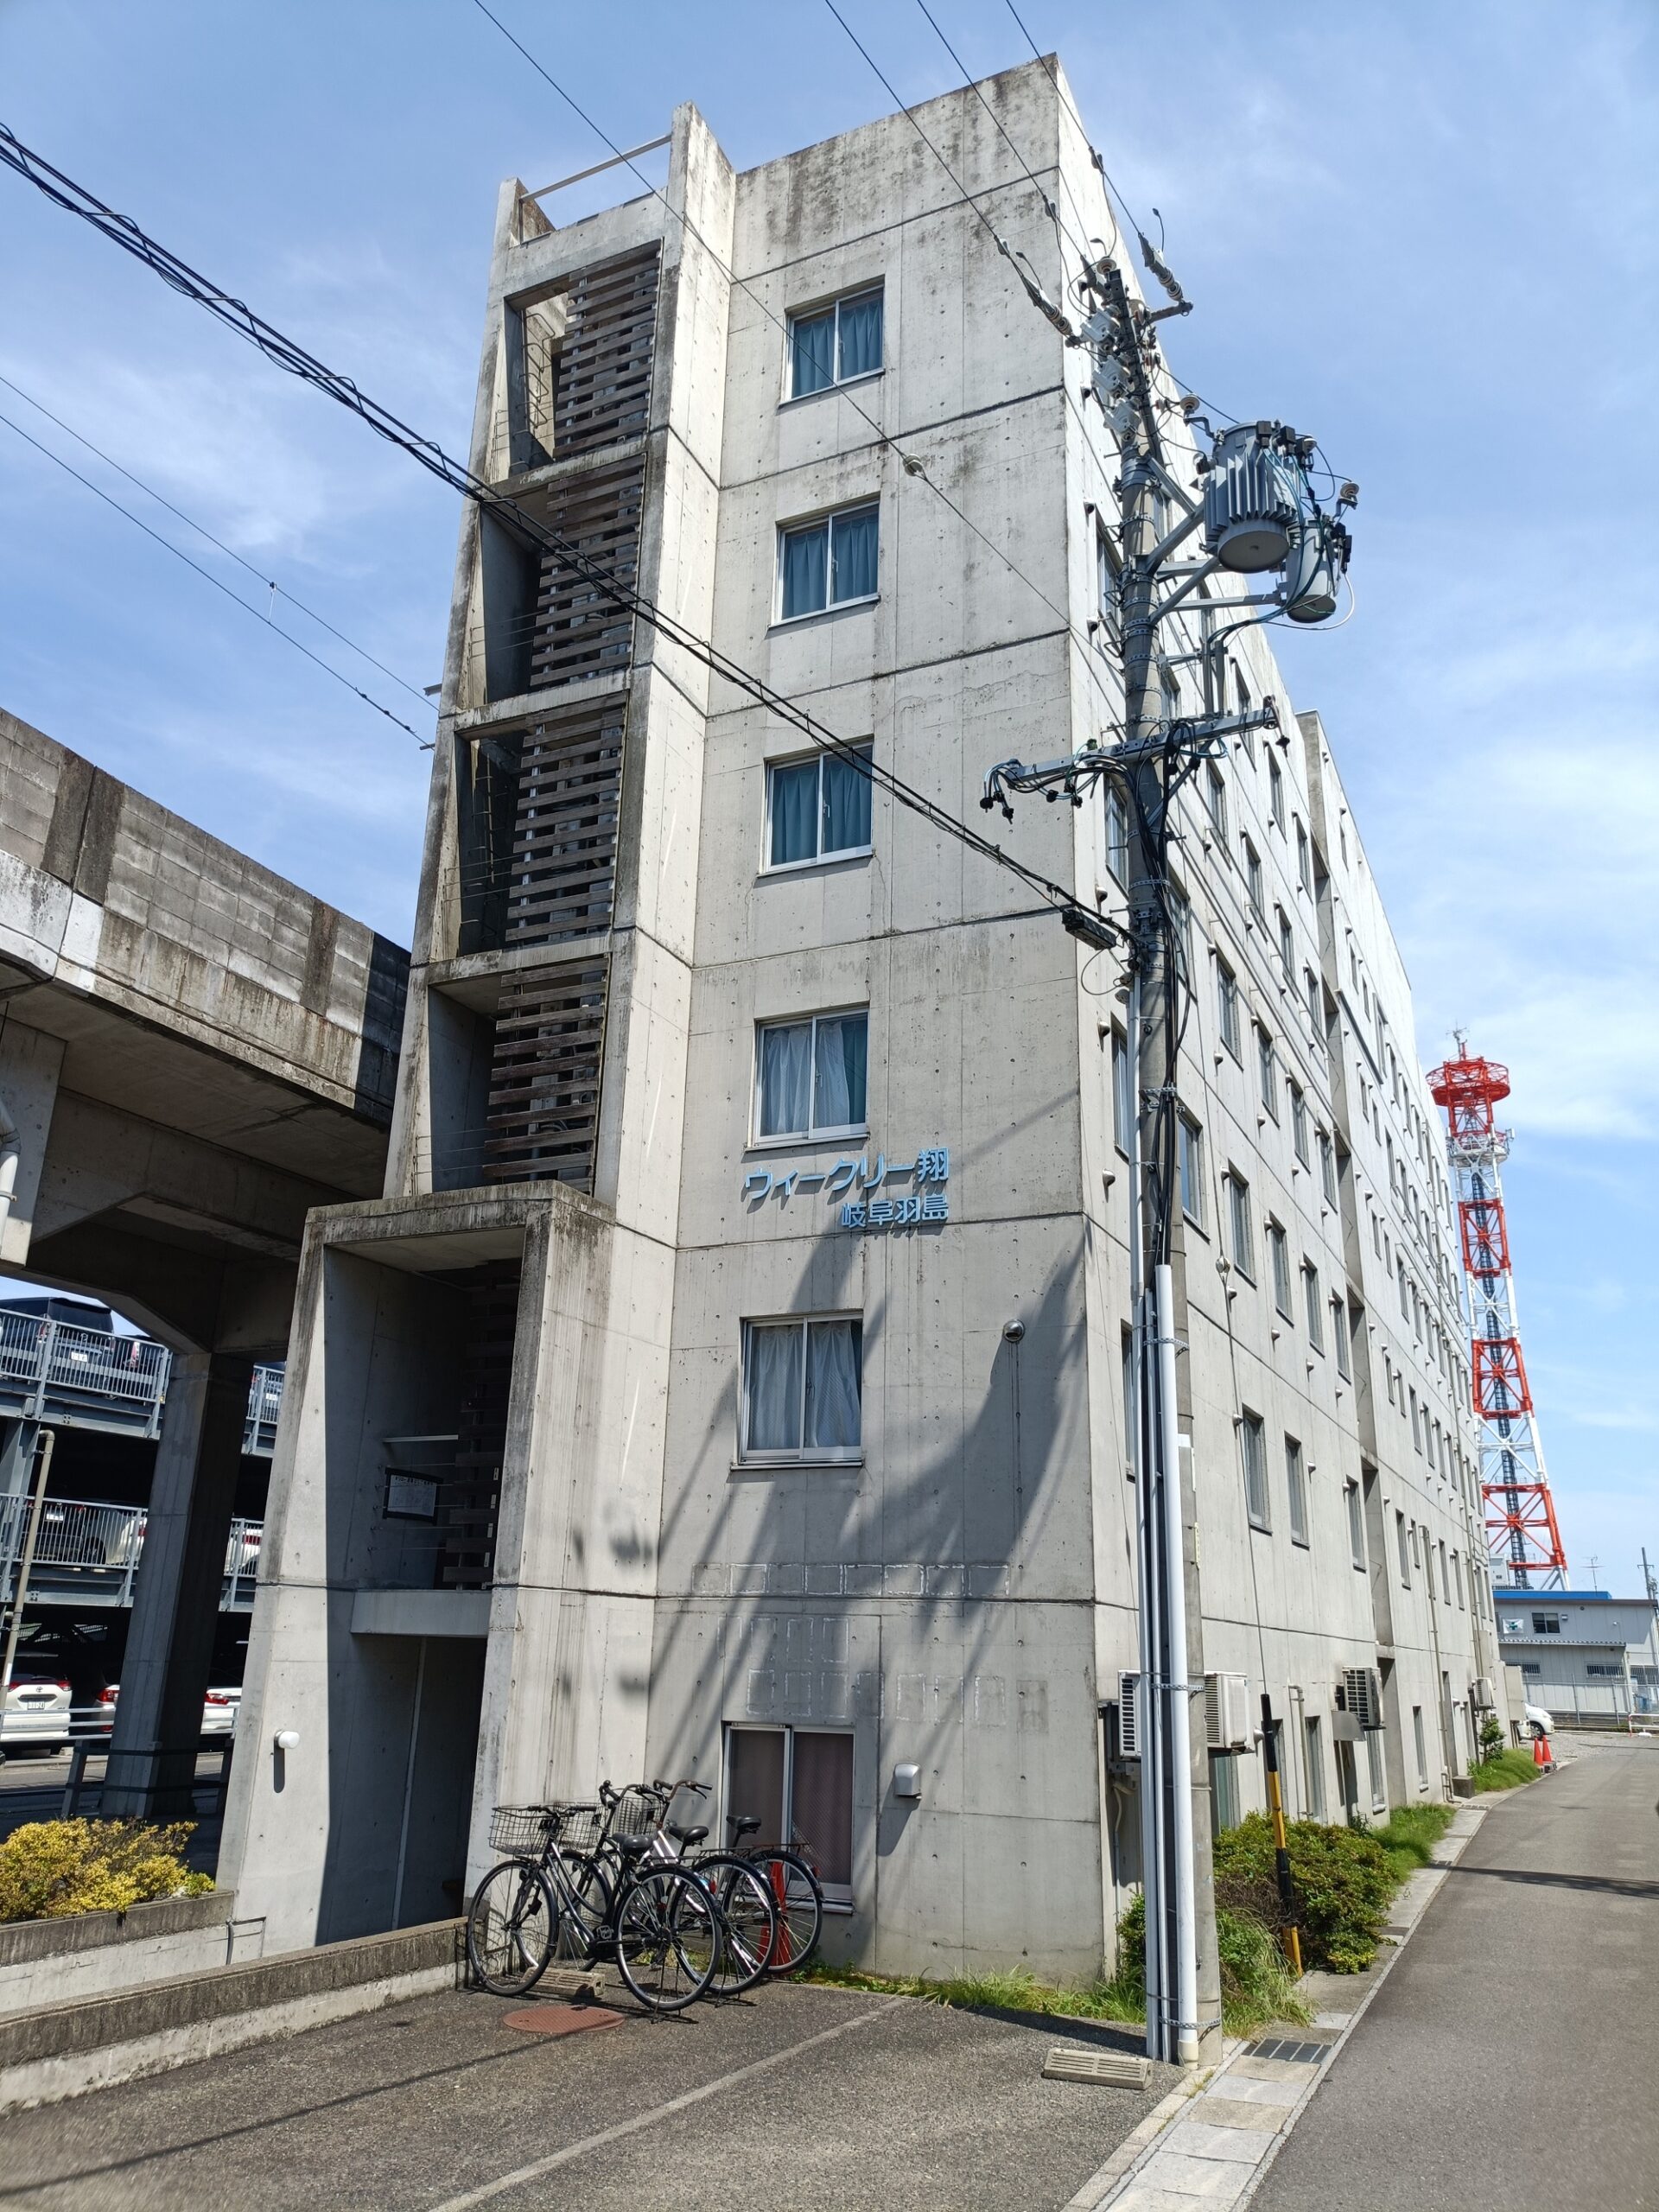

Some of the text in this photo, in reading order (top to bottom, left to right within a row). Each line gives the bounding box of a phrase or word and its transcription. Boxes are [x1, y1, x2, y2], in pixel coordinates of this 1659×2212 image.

[746, 1147, 949, 1199] ウィークリー翔
[842, 1194, 949, 1228] 岐阜羽島
